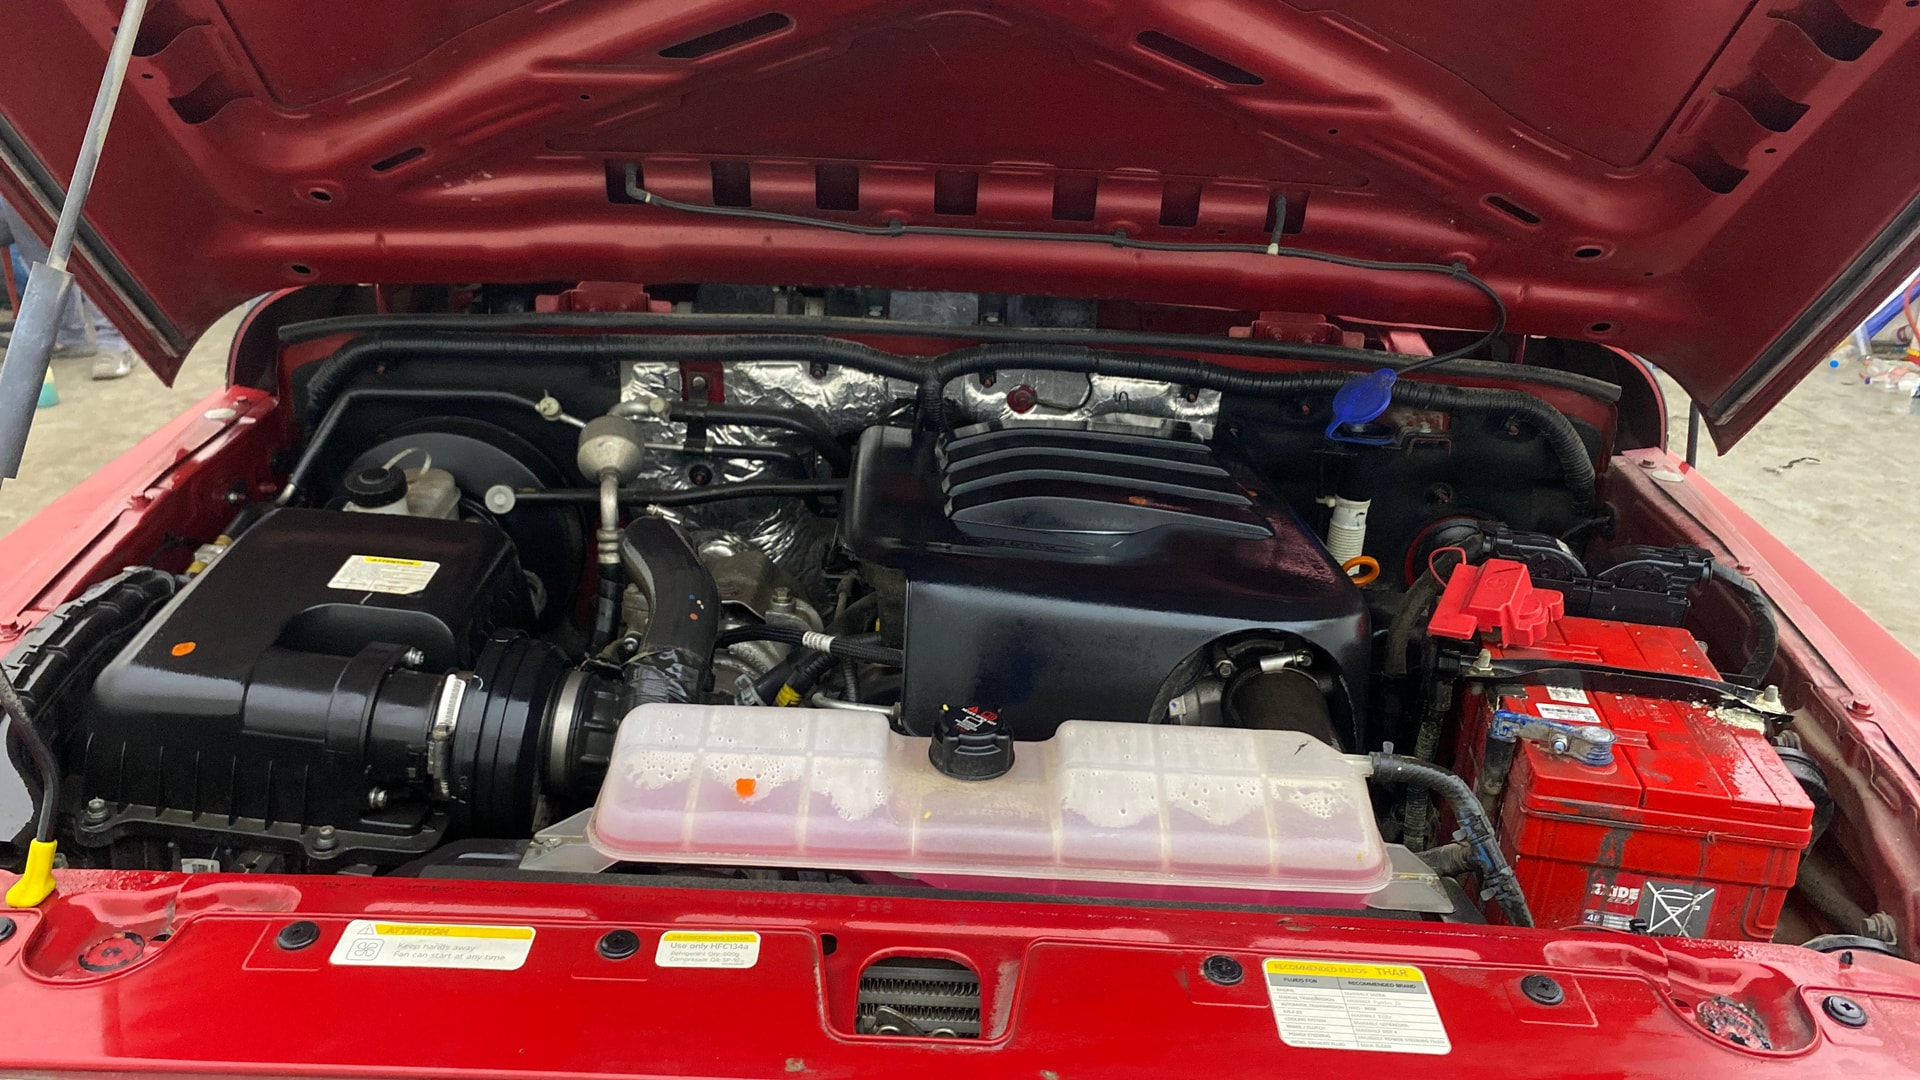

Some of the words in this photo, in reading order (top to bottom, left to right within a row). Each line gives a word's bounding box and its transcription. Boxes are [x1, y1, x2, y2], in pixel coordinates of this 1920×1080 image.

[385, 926, 450, 936] ATTENTION
[397, 943, 420, 951] Keep
[690, 942, 708, 950] only
[1274, 963, 1337, 973] RECOMMENDED
[1376, 968, 1408, 977] THAR
